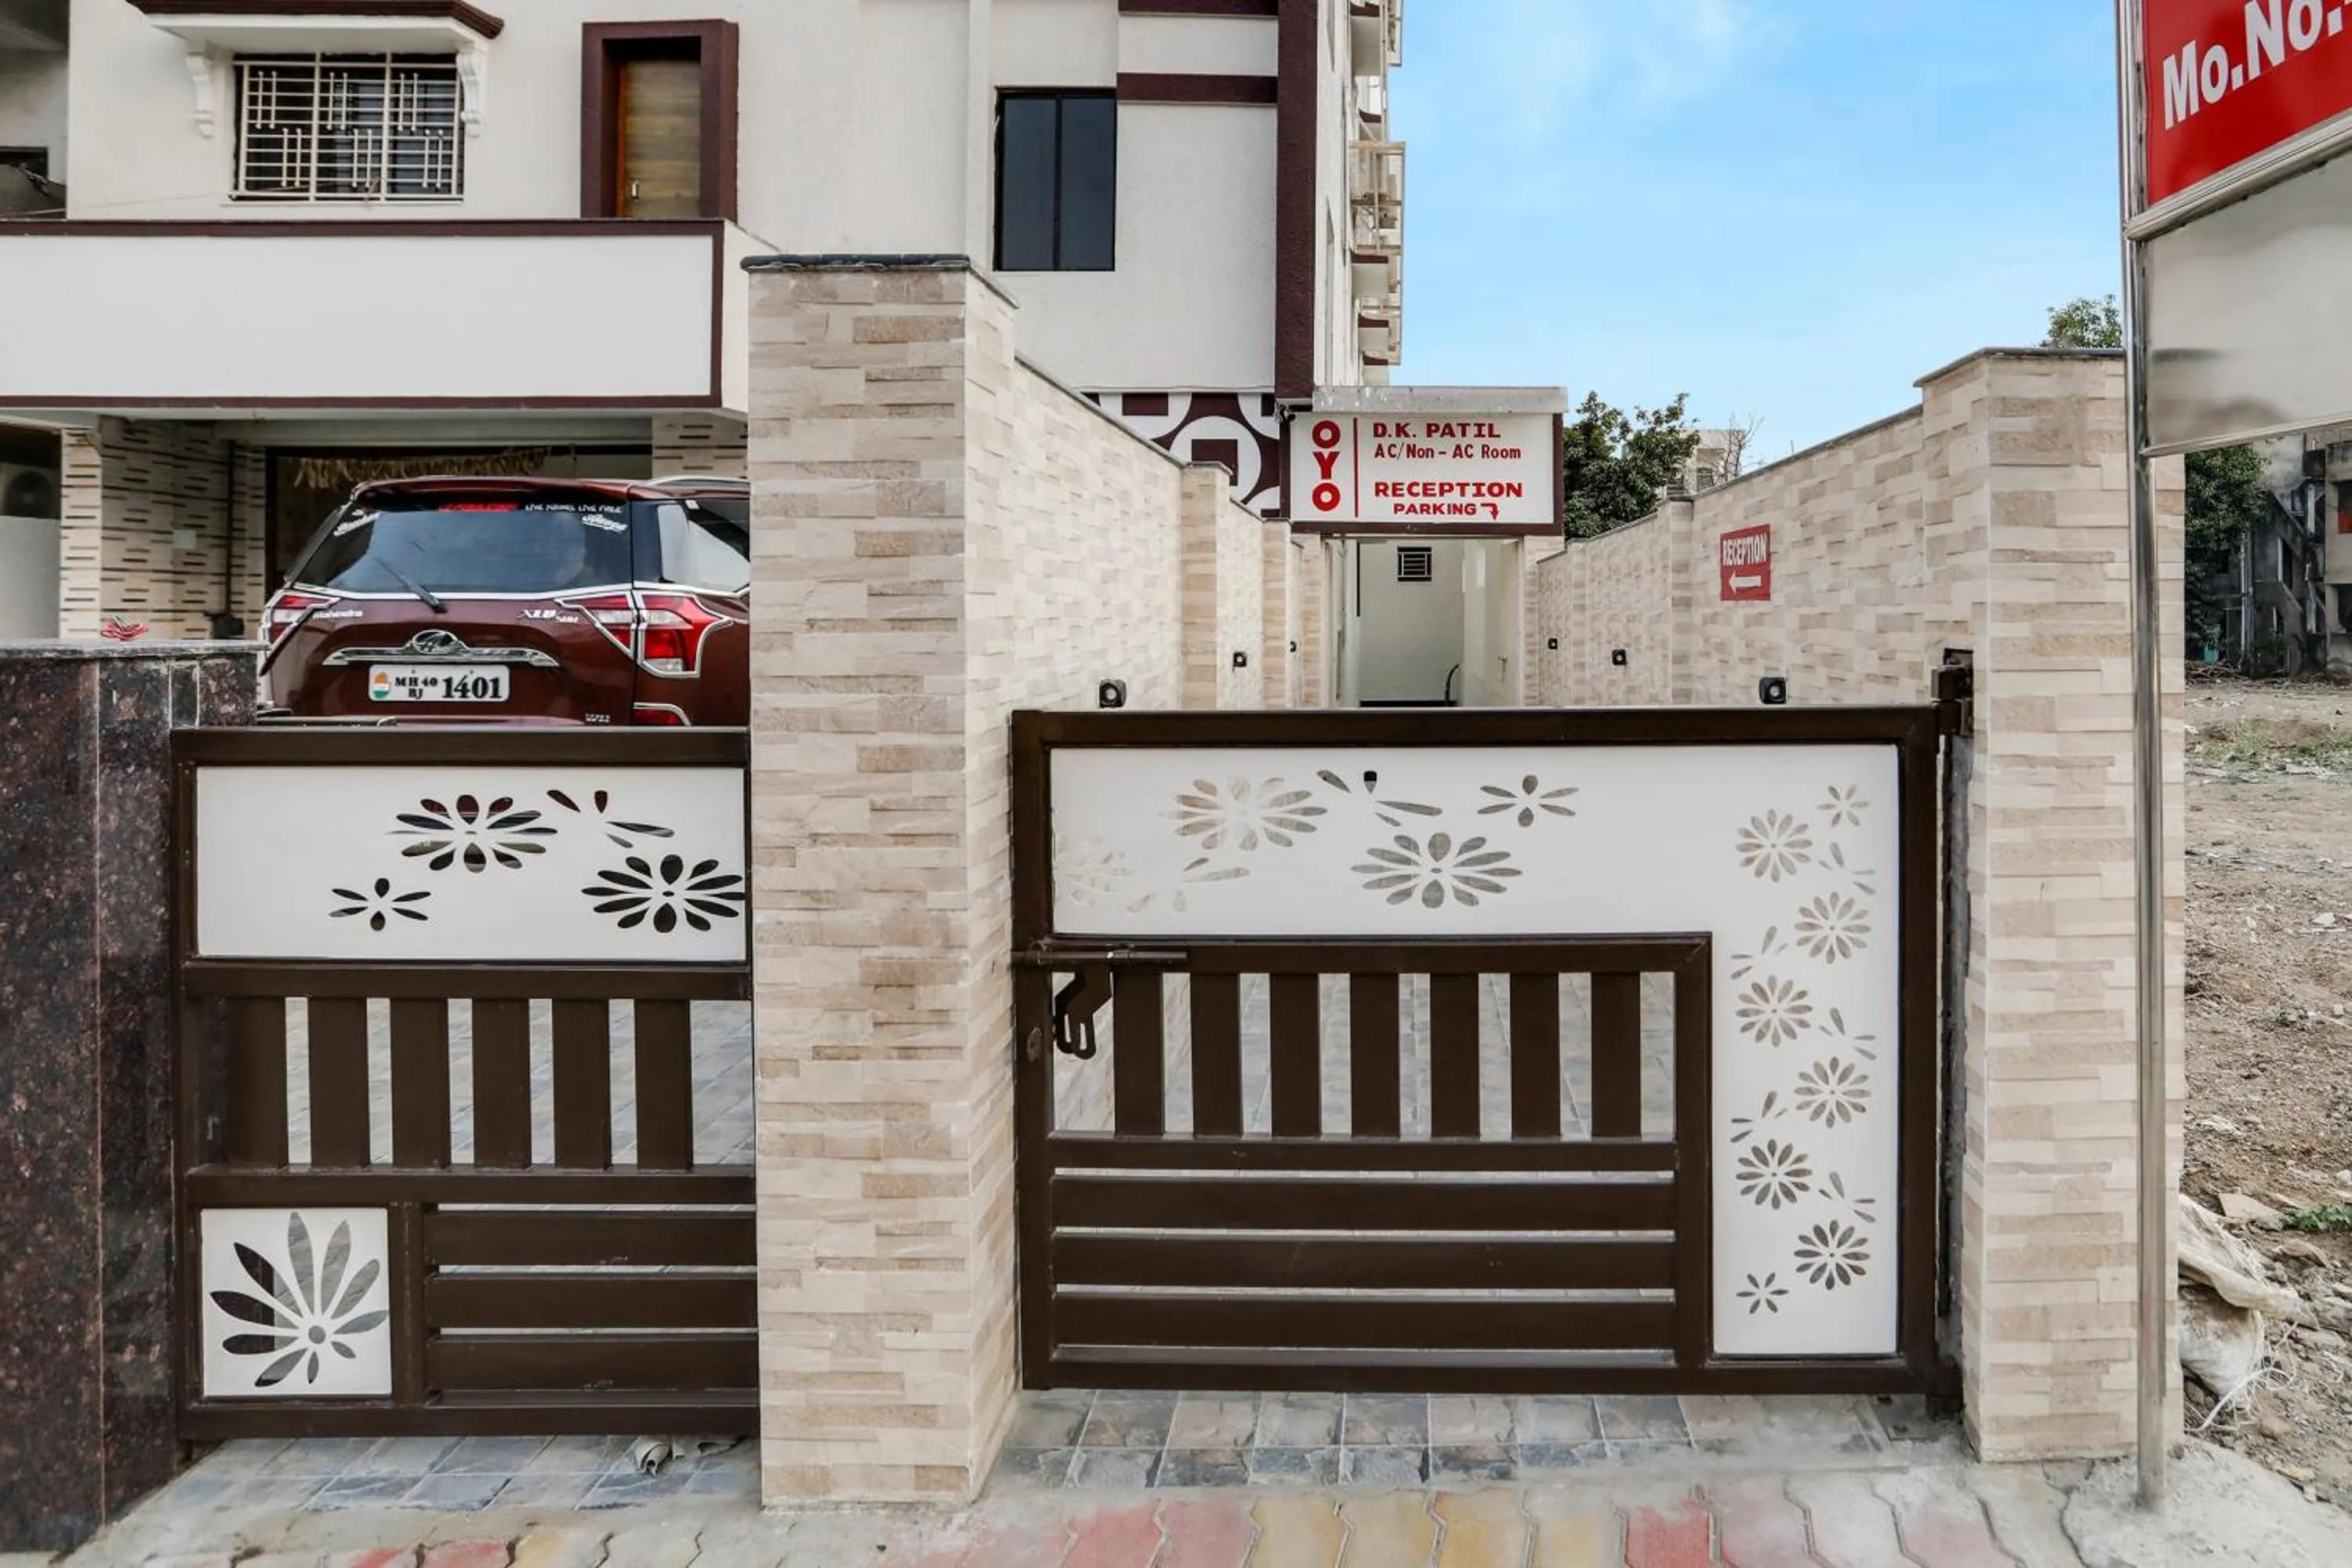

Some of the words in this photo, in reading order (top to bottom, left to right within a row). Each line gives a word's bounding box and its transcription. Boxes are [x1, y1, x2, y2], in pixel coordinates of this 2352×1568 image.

[1373, 423, 1417, 438] D.K.
[1426, 423, 1501, 438] PATIL
[1452, 444, 1474, 459] AC
[1481, 444, 1522, 459] Room
[1312, 419, 1341, 512] OYO
[1374, 481, 1523, 498] RECEPTION
[1393, 503, 1476, 515] PARKING
[1722, 533, 1768, 566] RECEPTION
[394, 677, 419, 687] MH
[422, 677, 438, 687] 40
[442, 674, 502, 699] 1401
